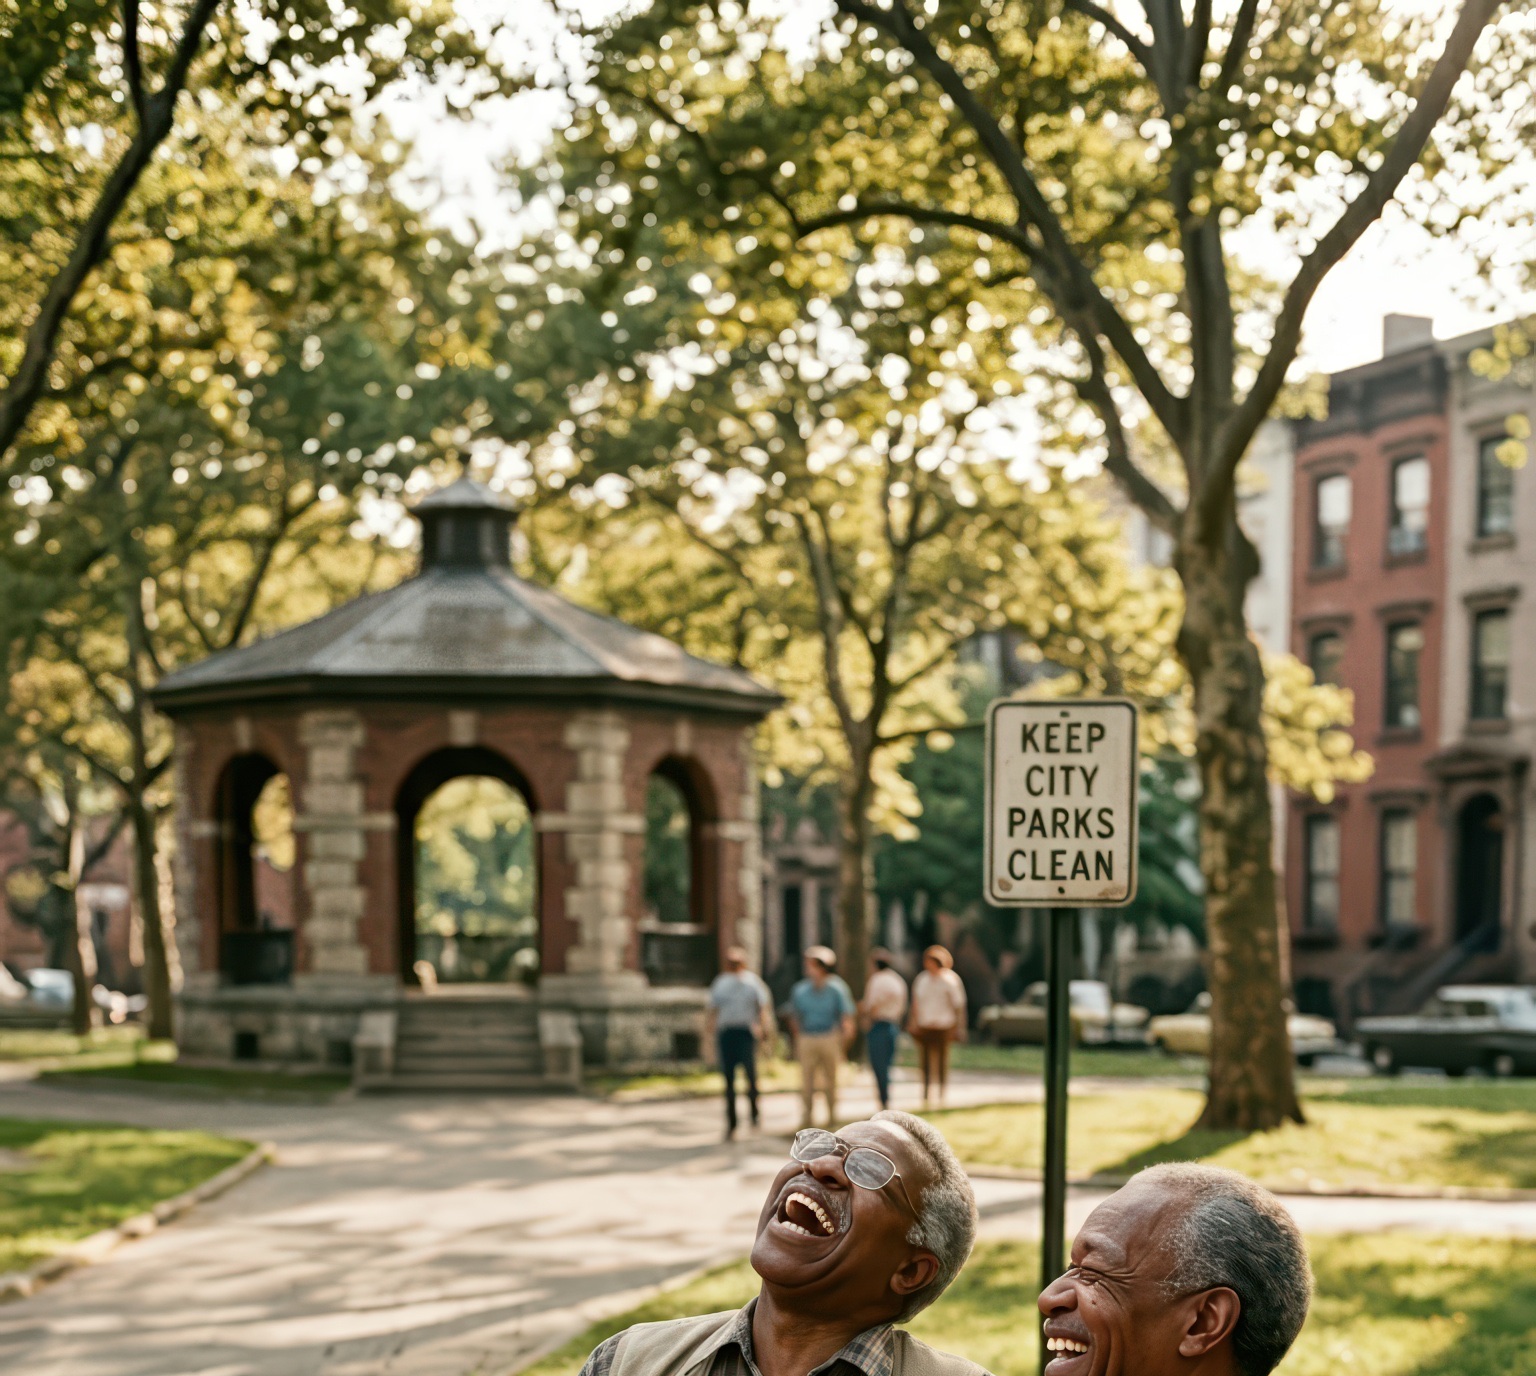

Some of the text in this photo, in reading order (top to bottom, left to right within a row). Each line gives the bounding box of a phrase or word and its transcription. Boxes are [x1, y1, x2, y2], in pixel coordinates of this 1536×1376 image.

[1021, 722, 1106, 753] KEEP
[1025, 764, 1099, 797] CITY
[1008, 807, 1115, 839] PARKS
[1008, 849, 1114, 881] CLEAN
